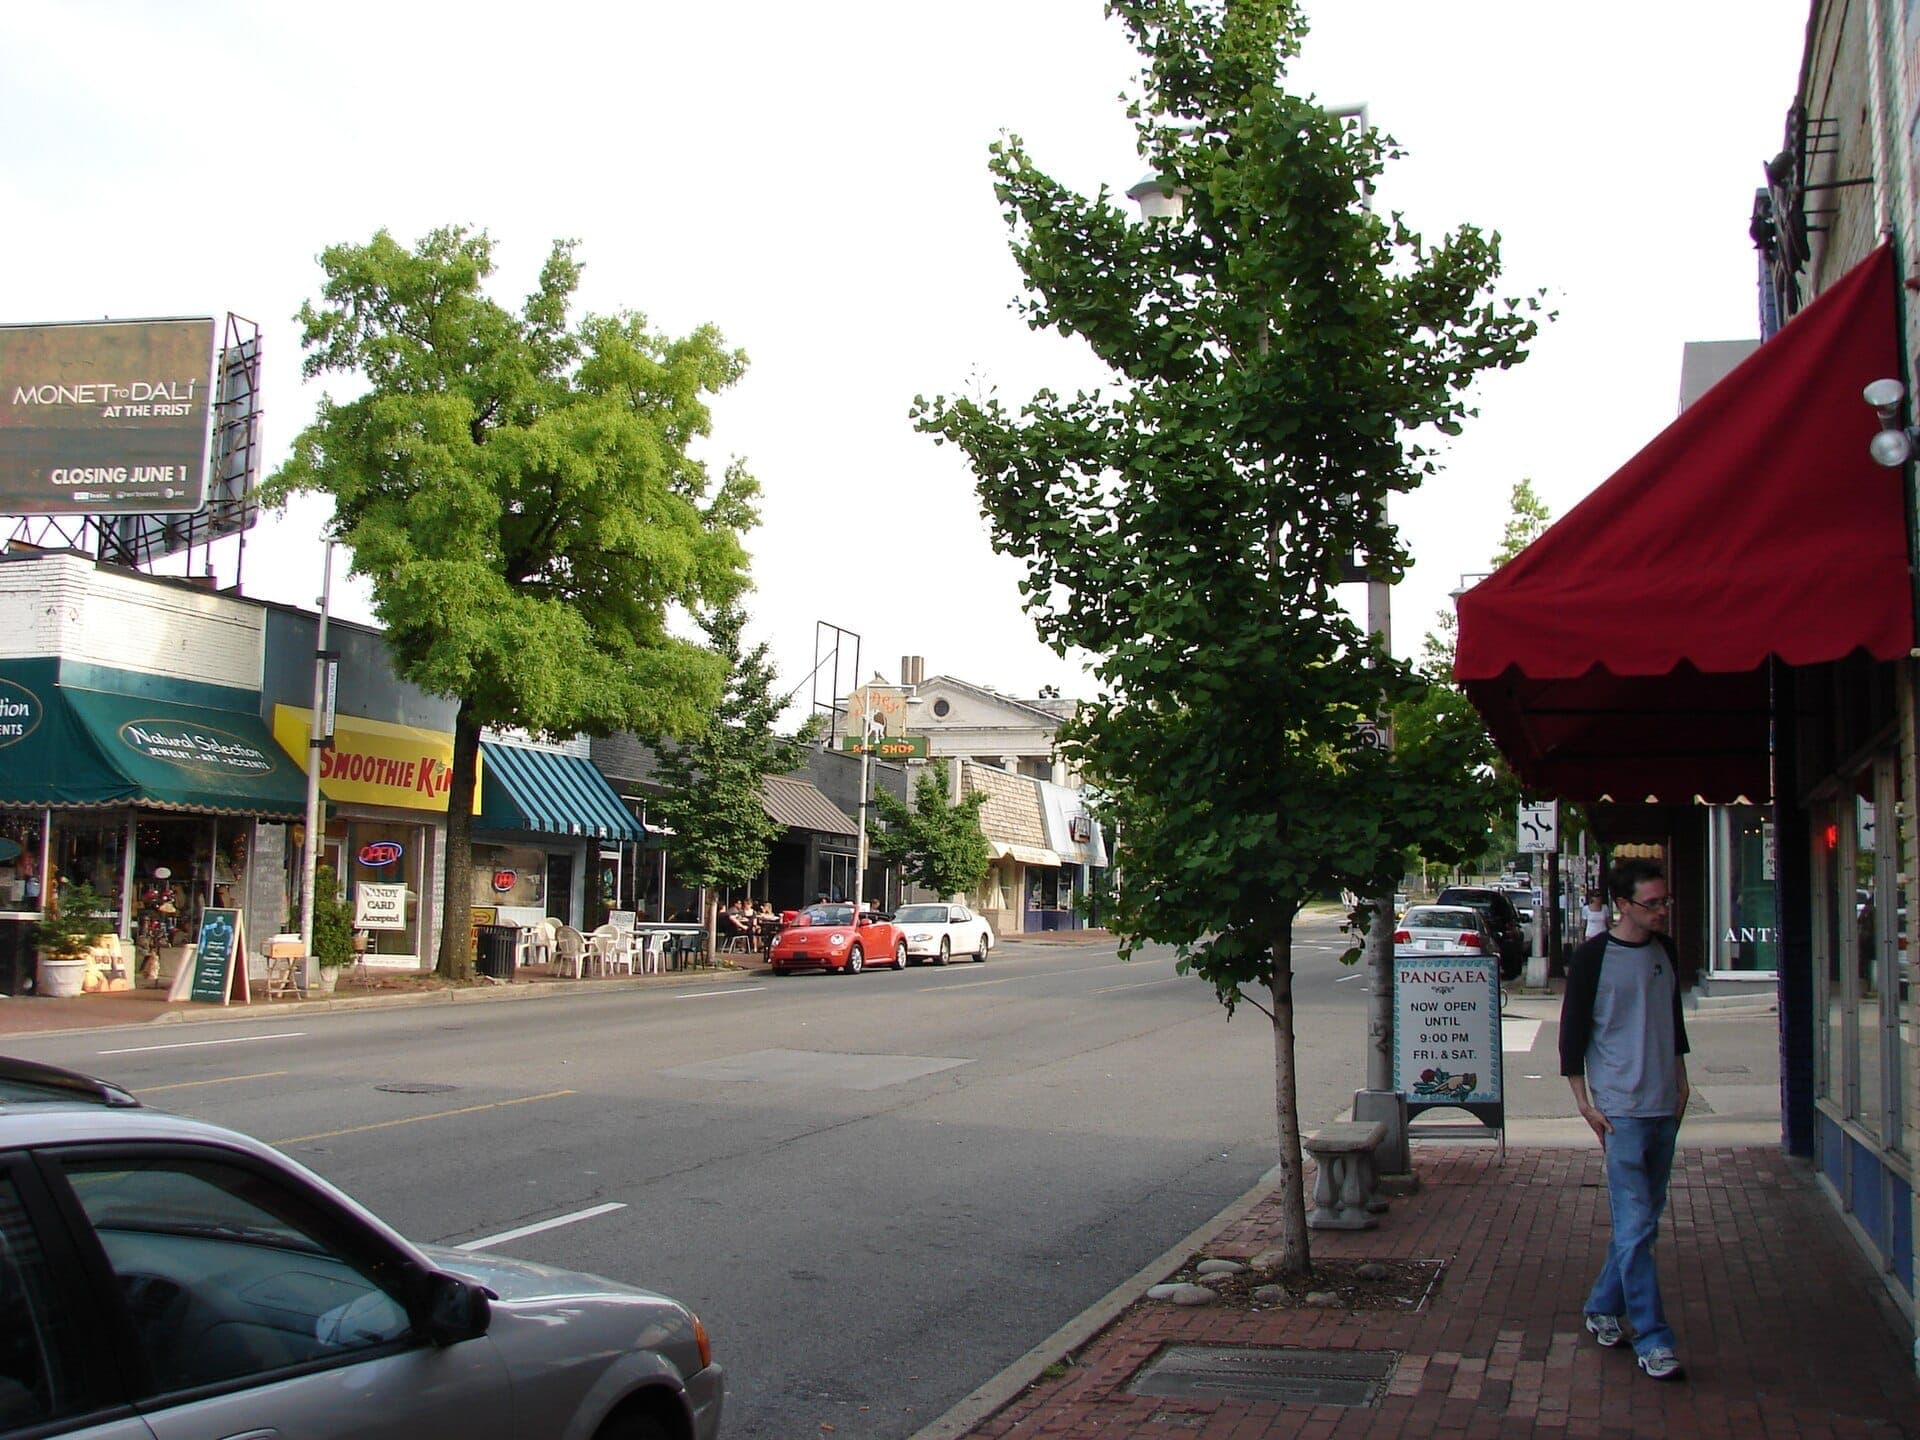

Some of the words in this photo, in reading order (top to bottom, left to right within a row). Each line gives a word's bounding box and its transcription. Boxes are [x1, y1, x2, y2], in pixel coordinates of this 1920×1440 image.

[13, 384, 117, 405] MONET
[112, 388, 129, 399] TO
[104, 406, 122, 418] AT
[126, 405, 150, 417] THE
[153, 404, 192, 416] FRIST
[52, 467, 127, 485] CLOSING
[130, 466, 174, 483] JUNE
[178, 465, 187, 482] 1
[127, 726, 197, 749] Natural
[194, 735, 265, 760] Selection
[881, 744, 915, 754] SHOP
[320, 743, 415, 788] SMOOTHIE
[360, 846, 399, 862] OPEN
[367, 900, 396, 910] CARD
[1400, 971, 1488, 984] PANGAEA
[1410, 1002, 1438, 1012] NOW
[1443, 1001, 1477, 1012] OPEN
[1425, 1017, 1461, 1027] UNTIL
[1420, 1033, 1448, 1043] 9:00
[1451, 1033, 1469, 1043] PM
[1413, 1050, 1438, 1060] FRI.
[1440, 1050, 1449, 1060] &
[1451, 1050, 1477, 1060] SAT.
